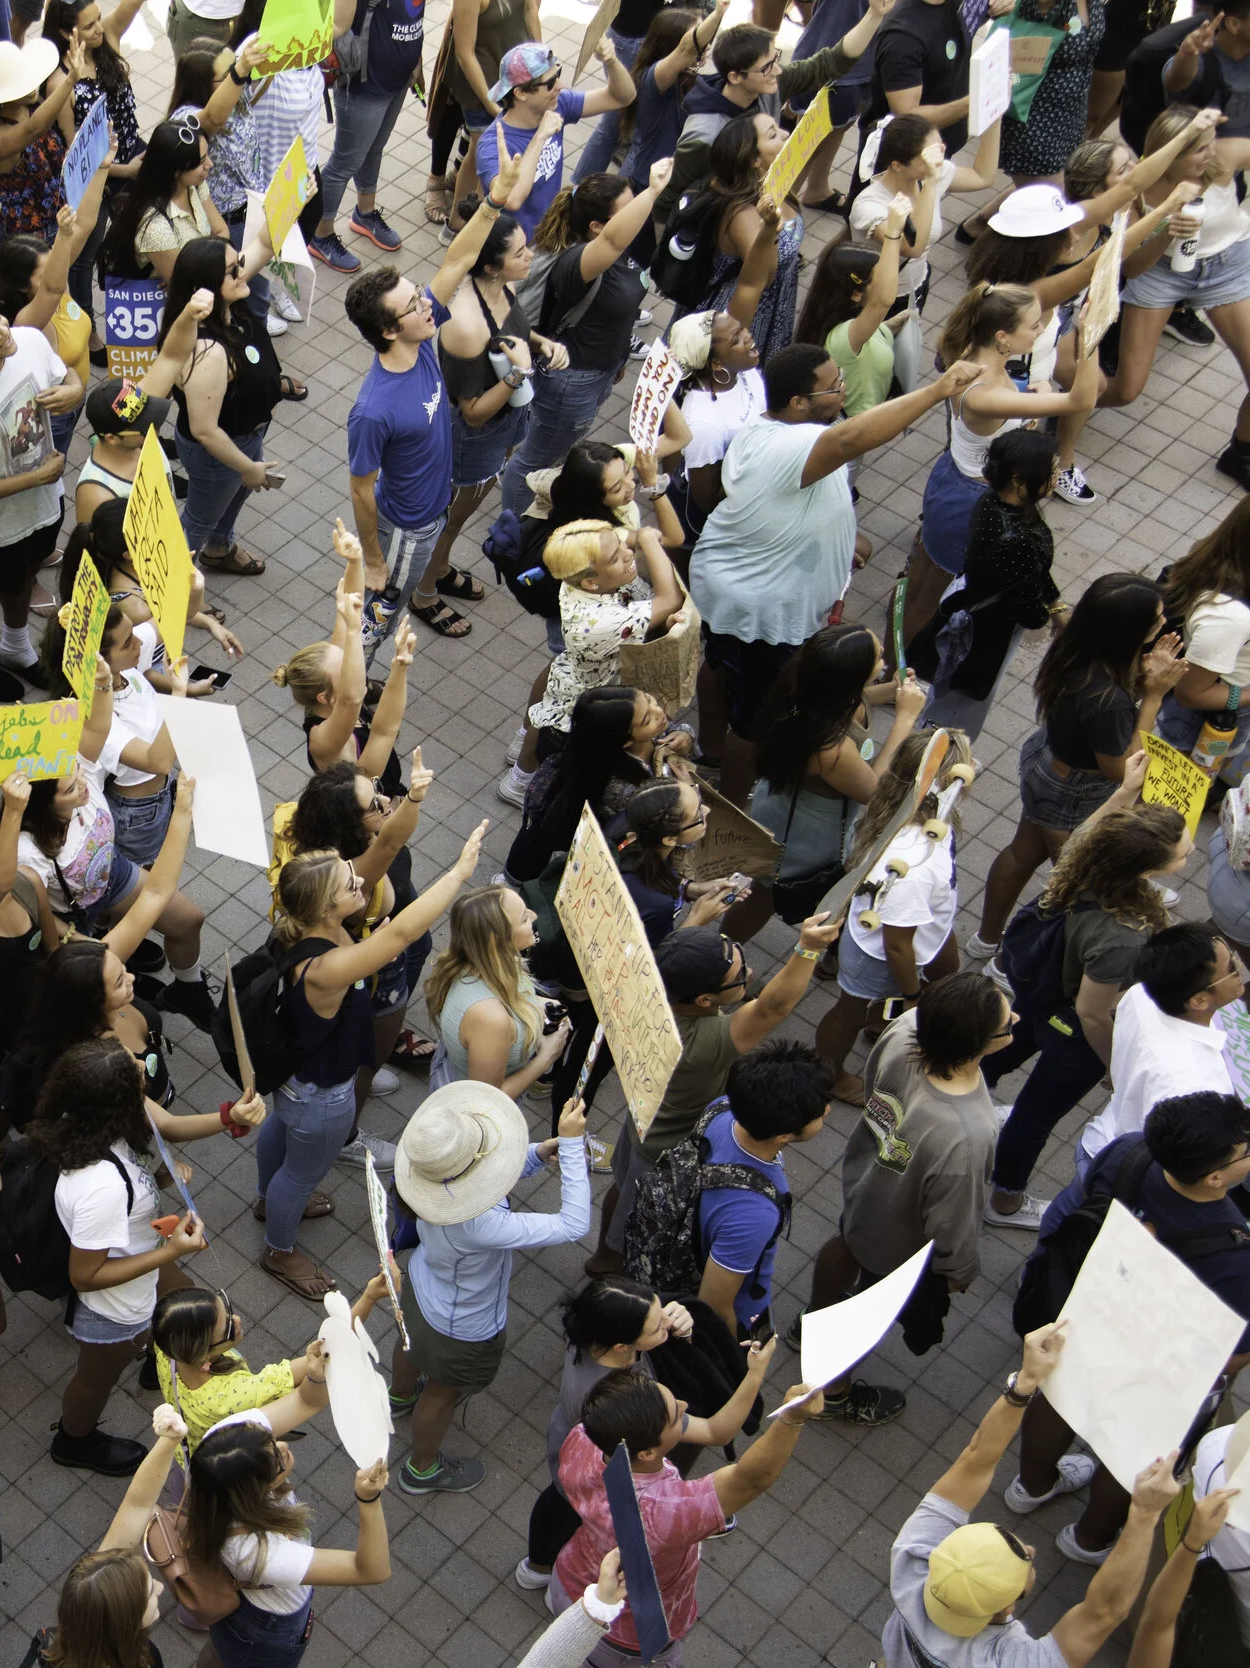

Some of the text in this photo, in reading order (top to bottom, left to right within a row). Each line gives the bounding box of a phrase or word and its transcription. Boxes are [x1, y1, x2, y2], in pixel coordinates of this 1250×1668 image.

[392, 23, 410, 34] THE
[78, 100, 107, 156] PLANET
[109, 288, 130, 301] SAN
[110, 349, 159, 363] CLIMA
[642, 355, 653, 380] UP
[651, 352, 669, 382] YOU
[124, 461, 149, 551] WHAT
[138, 485, 164, 590] GRETA
[148, 538, 169, 624] SAID
[64, 559, 93, 679] DESTROY THE
[50, 702, 79, 725] ON
[1146, 735, 1177, 758] DON'T
[1179, 758, 1193, 774] LET
[1195, 773, 1206, 788] US
[1148, 746, 1178, 772] INVEST
[1181, 771, 1190, 786] IN
[1191, 783, 1198, 794] A
[1161, 767, 1193, 801] FUTURE
[1148, 771, 1162, 791] WE
[1163, 788, 1191, 817] WON'T
[713, 827, 753, 846] future
[571, 900, 586, 938] ALL
[574, 863, 630, 990] MOTHER
[592, 850, 634, 946] STAND
[631, 944, 651, 980] UP
[647, 987, 671, 1056] FOR
